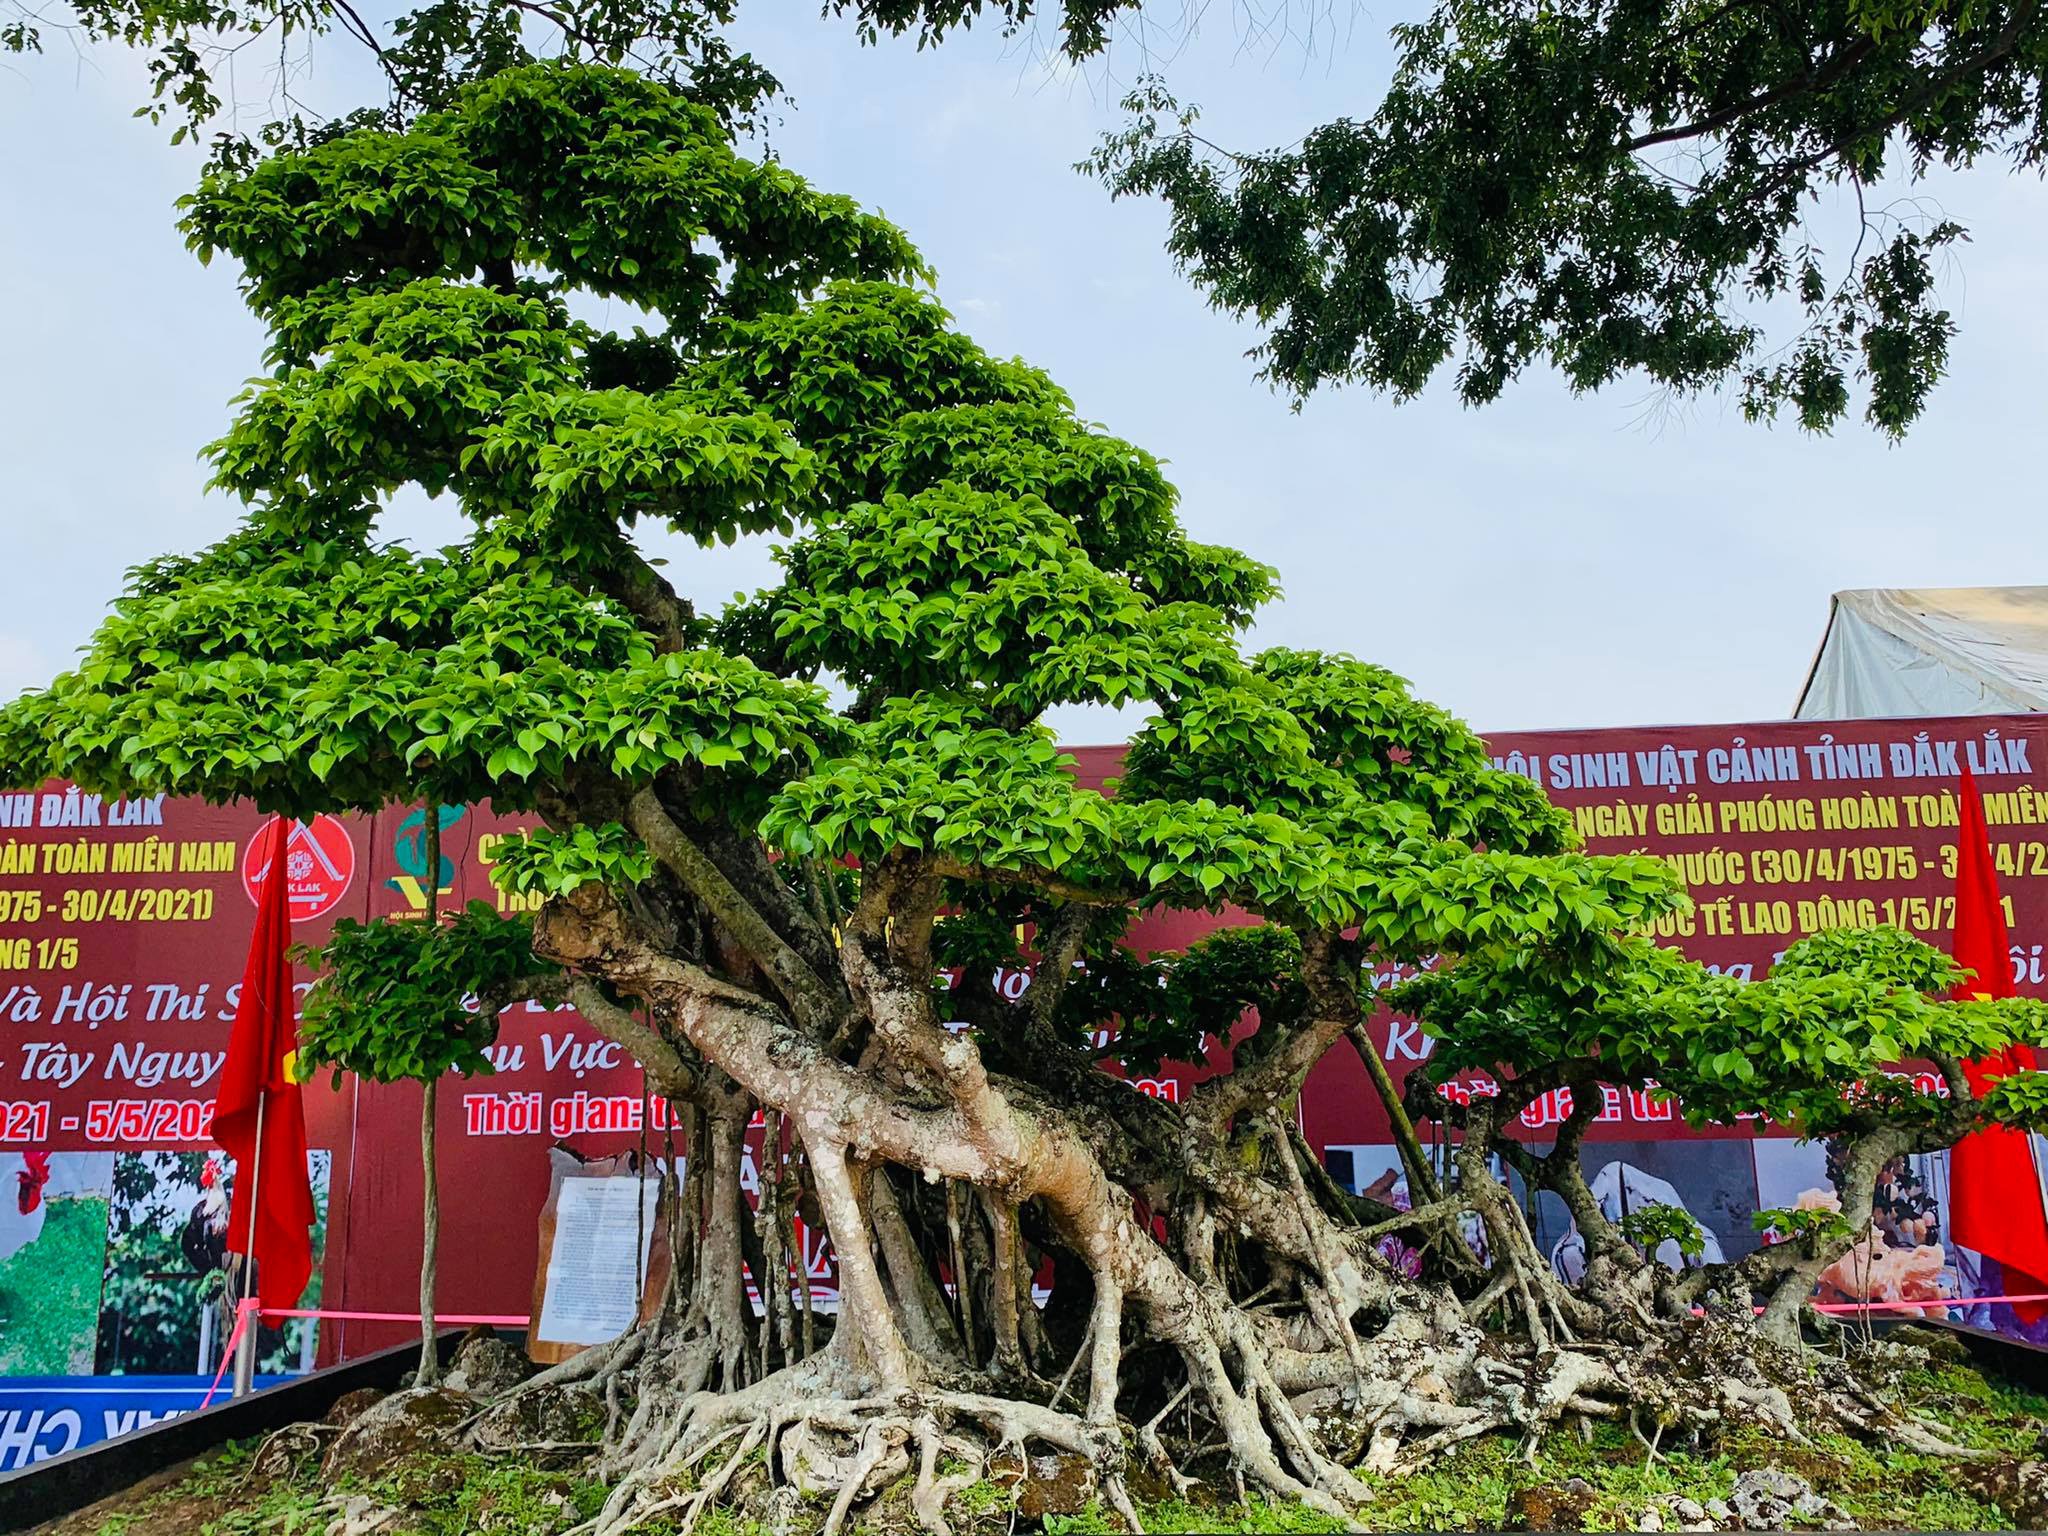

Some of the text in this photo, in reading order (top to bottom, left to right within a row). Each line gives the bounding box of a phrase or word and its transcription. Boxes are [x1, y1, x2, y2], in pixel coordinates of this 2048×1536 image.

[1549, 752, 1631, 790] SINH
[1634, 744, 1699, 794] VẬT
[1706, 736, 1800, 784] CẢNH
[1803, 733, 1884, 780] TỈNH
[1889, 731, 1962, 778] ĐẮK
[1965, 729, 2033, 775] LẮK
[40, 784, 103, 828] ĐẮK
[1575, 798, 1649, 838] NGÀY
[1655, 792, 1715, 836] GIẢI
[1719, 793, 1817, 833] PHÓNG
[1820, 790, 1900, 831] HOÀN
[1901, 788, 1961, 828] TOÀ
[0, 834, 236, 875] ÀN TOÀN MIỀN NAM
[62, 888, 214, 922] 30/4/2021)
[1699, 894, 1735, 937] TẾ
[1738, 900, 1793, 935] LAO
[37, 937, 79, 970] 1/5
[51, 981, 133, 1030] Hội
[145, 983, 211, 1022] Thi
[20, 1041, 227, 1089] Tây Nguy
[540, 1032, 622, 1079] Vực
[85, 1098, 218, 1142] 5/5/202
[463, 1091, 543, 1136] Thời
[551, 1090, 643, 1138] gian:
